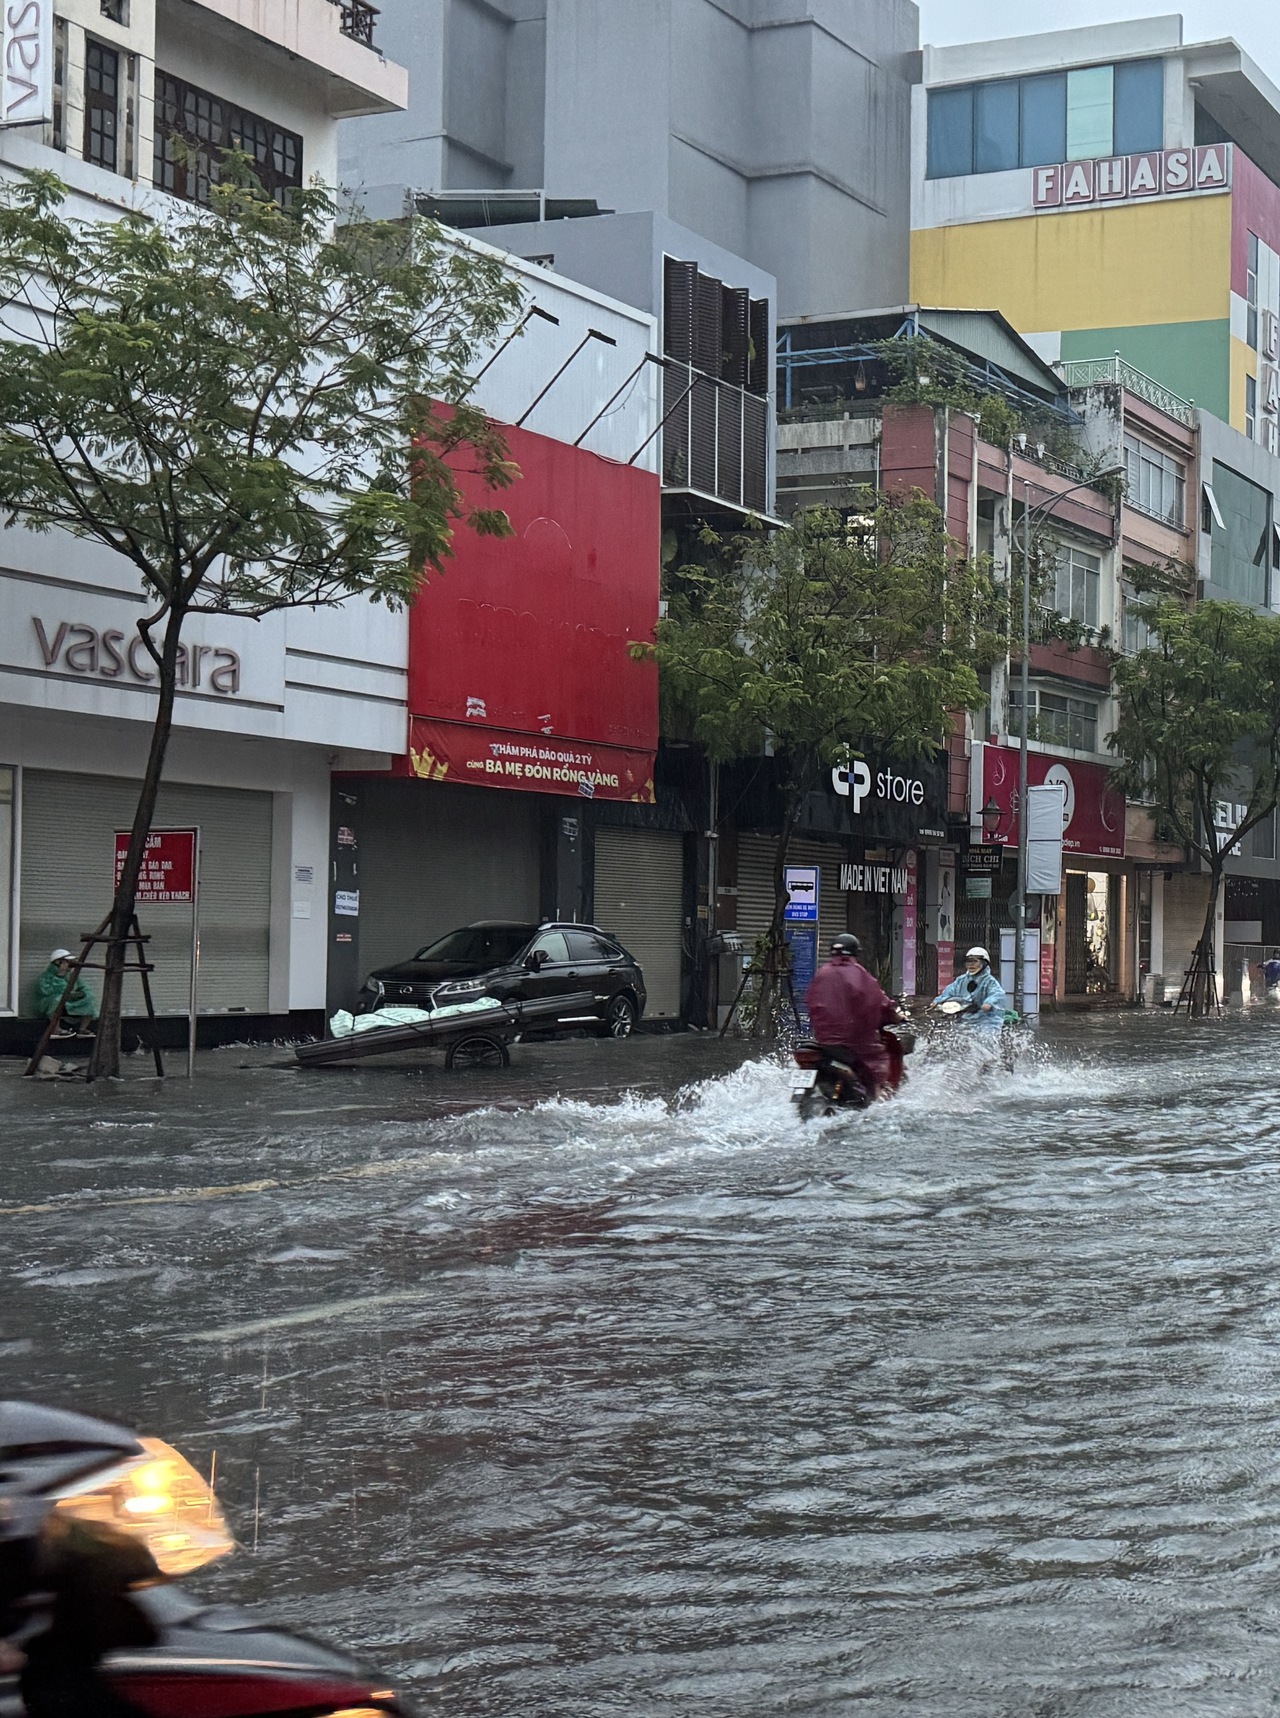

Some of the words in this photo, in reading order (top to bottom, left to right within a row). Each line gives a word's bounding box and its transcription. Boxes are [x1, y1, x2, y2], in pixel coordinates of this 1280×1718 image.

[1037, 148, 1223, 203] FAHASA
[521, 745, 538, 759] PHÁ
[576, 753, 581, 763] 2
[485, 759, 504, 774] BA
[505, 760, 523, 780] MẸ
[524, 761, 551, 777] ĐÓN
[588, 769, 619, 787] VÀNG
[877, 767, 924, 805] store
[984, 855, 1000, 863] CHI
[840, 864, 863, 891] MADE
[864, 865, 872, 892] IN
[873, 866, 890, 893] VIET
[891, 868, 908, 894] NAM
